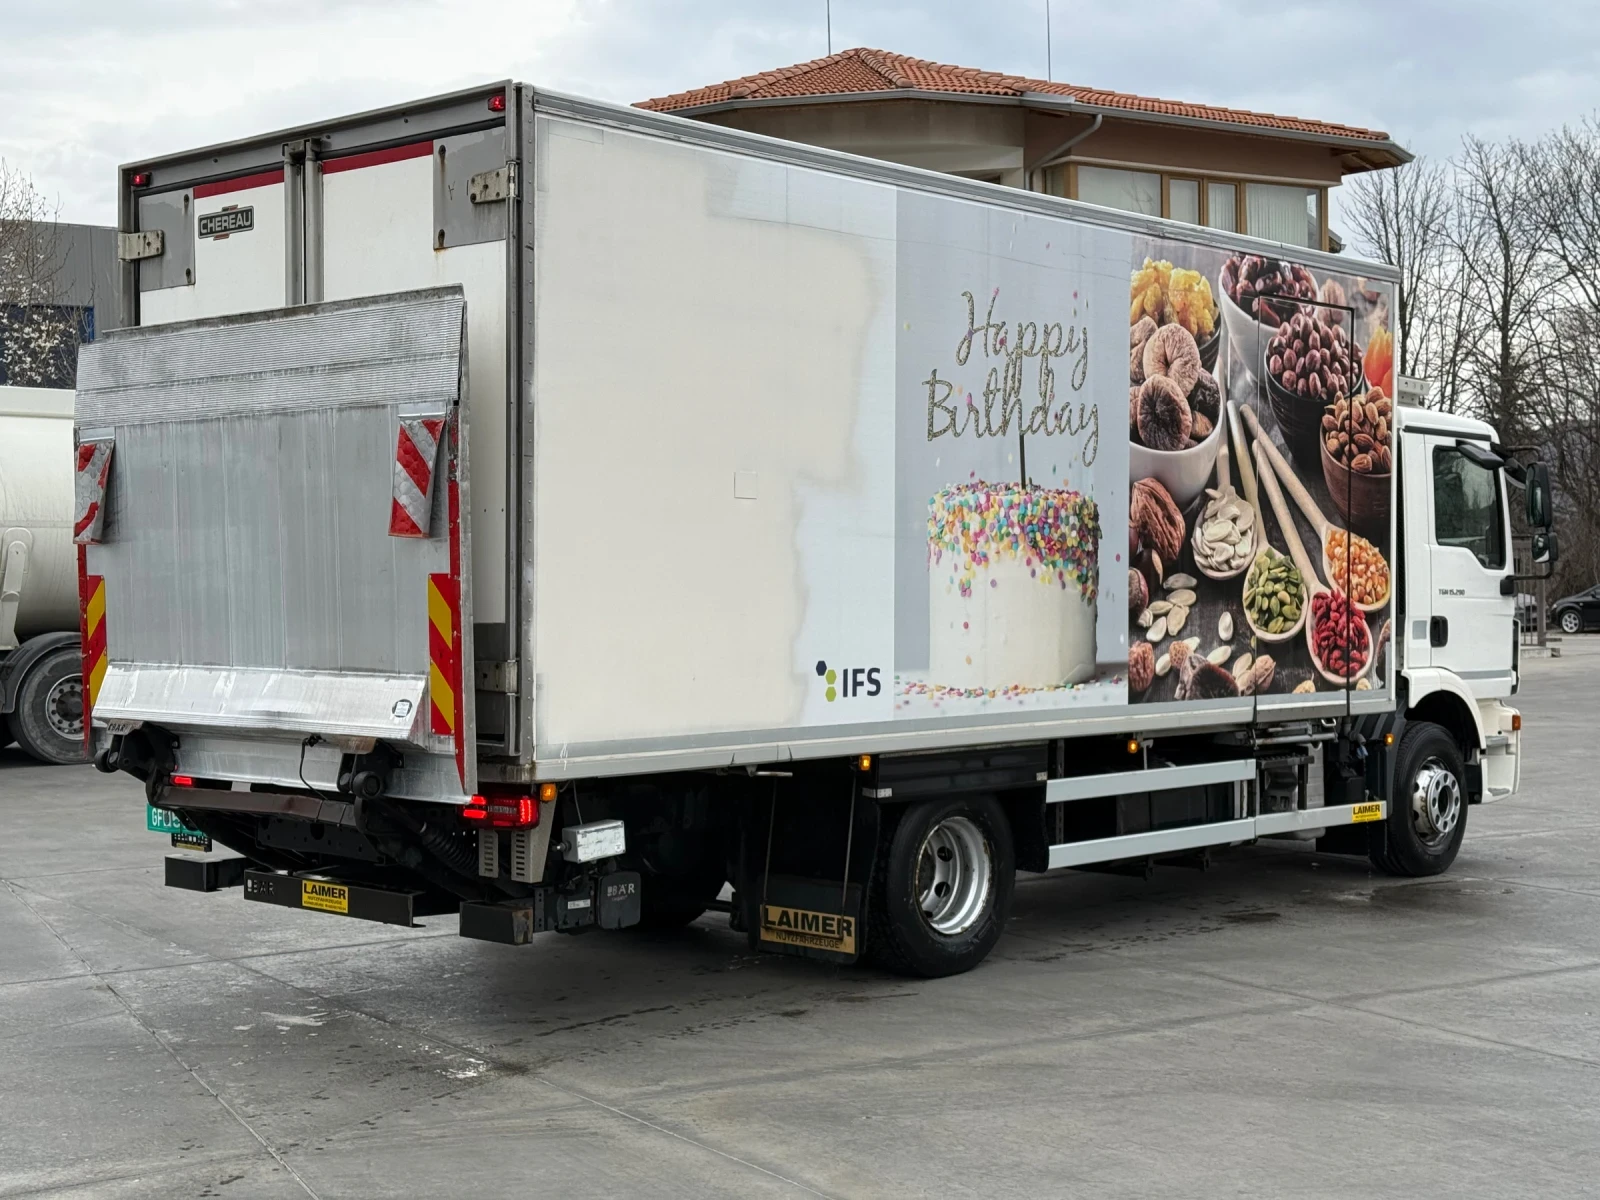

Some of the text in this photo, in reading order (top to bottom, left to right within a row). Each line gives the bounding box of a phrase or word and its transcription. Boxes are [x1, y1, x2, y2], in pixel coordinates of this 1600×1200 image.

[200, 211, 252, 234] CHEREAU
[956, 288, 1088, 397] Happy
[922, 367, 1099, 468] Birthday
[842, 667, 882, 698] IFS
[1352, 804, 1381, 815] LAIMER
[303, 882, 347, 900] LAIMER
[763, 907, 853, 938] LAIMER
[775, 931, 840, 949] NUTZFAHRZEUGE
